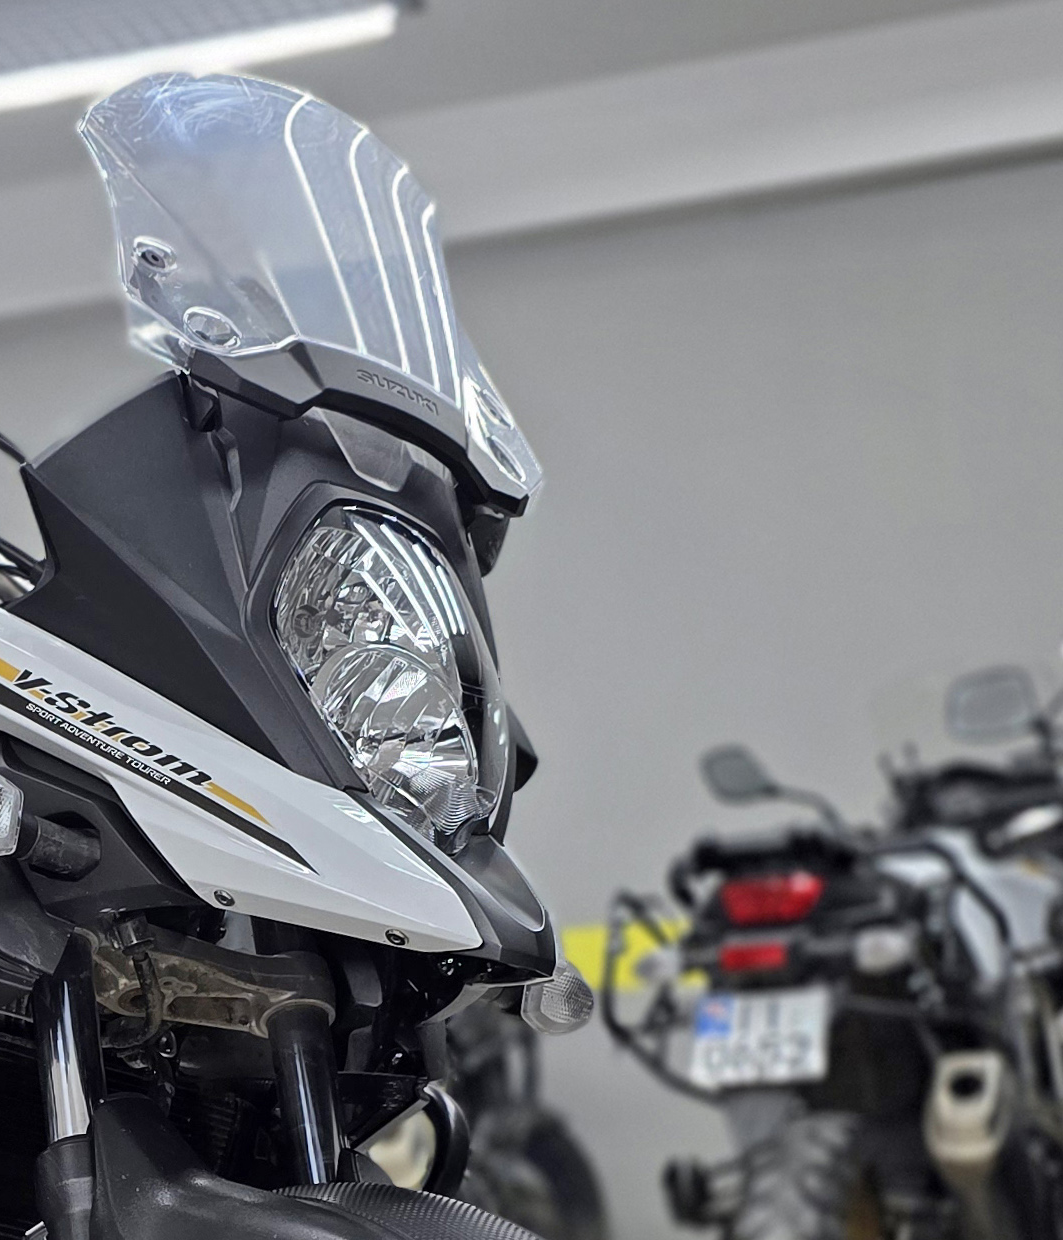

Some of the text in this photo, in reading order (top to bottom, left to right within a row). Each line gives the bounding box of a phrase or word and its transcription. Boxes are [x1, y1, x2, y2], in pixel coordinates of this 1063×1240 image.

[356, 369, 439, 416] SUZUKI
[13, 669, 212, 786] V-Strom
[25, 702, 172, 785] SPORT ADVENTURE TOURER
